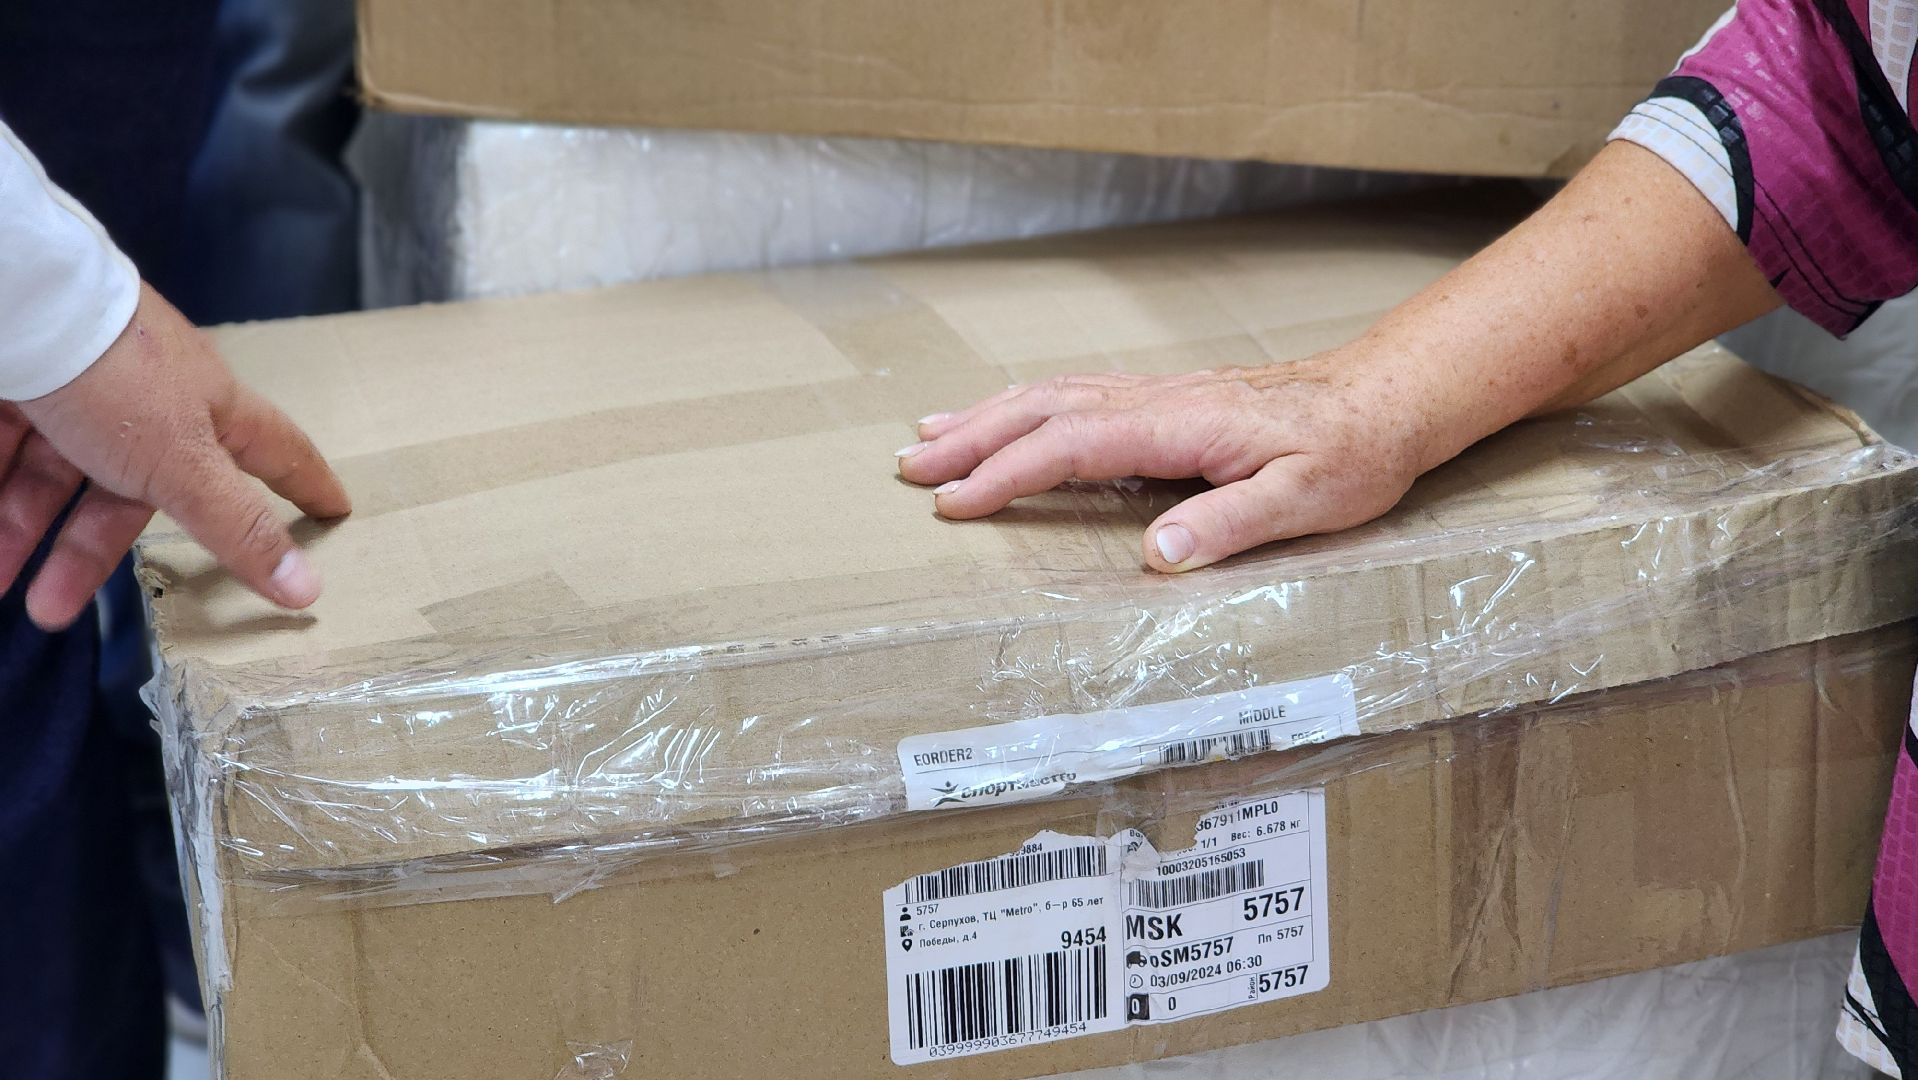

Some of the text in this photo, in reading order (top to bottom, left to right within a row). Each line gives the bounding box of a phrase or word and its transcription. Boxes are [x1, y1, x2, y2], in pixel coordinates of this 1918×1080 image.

[1238, 704, 1287, 725] MIDDLE
[913, 747, 973, 766] EORDER2
[1200, 819, 1301, 849] 1/1 Вес: 6.678 кг
[916, 903, 939, 916] 5757
[929, 913, 980, 930] Серпухов,
[983, 911, 997, 924] ТЦ
[1071, 897, 1084, 908] 65
[1086, 896, 1104, 907] лет
[1125, 886, 1305, 941] MSK 5757
[919, 935, 960, 949] Победы,
[1060, 926, 1107, 950] 9454
[1277, 925, 1305, 941] 5757
[1150, 954, 1263, 989] 03/09/2024 06:30
[1258, 965, 1309, 993] 5757
